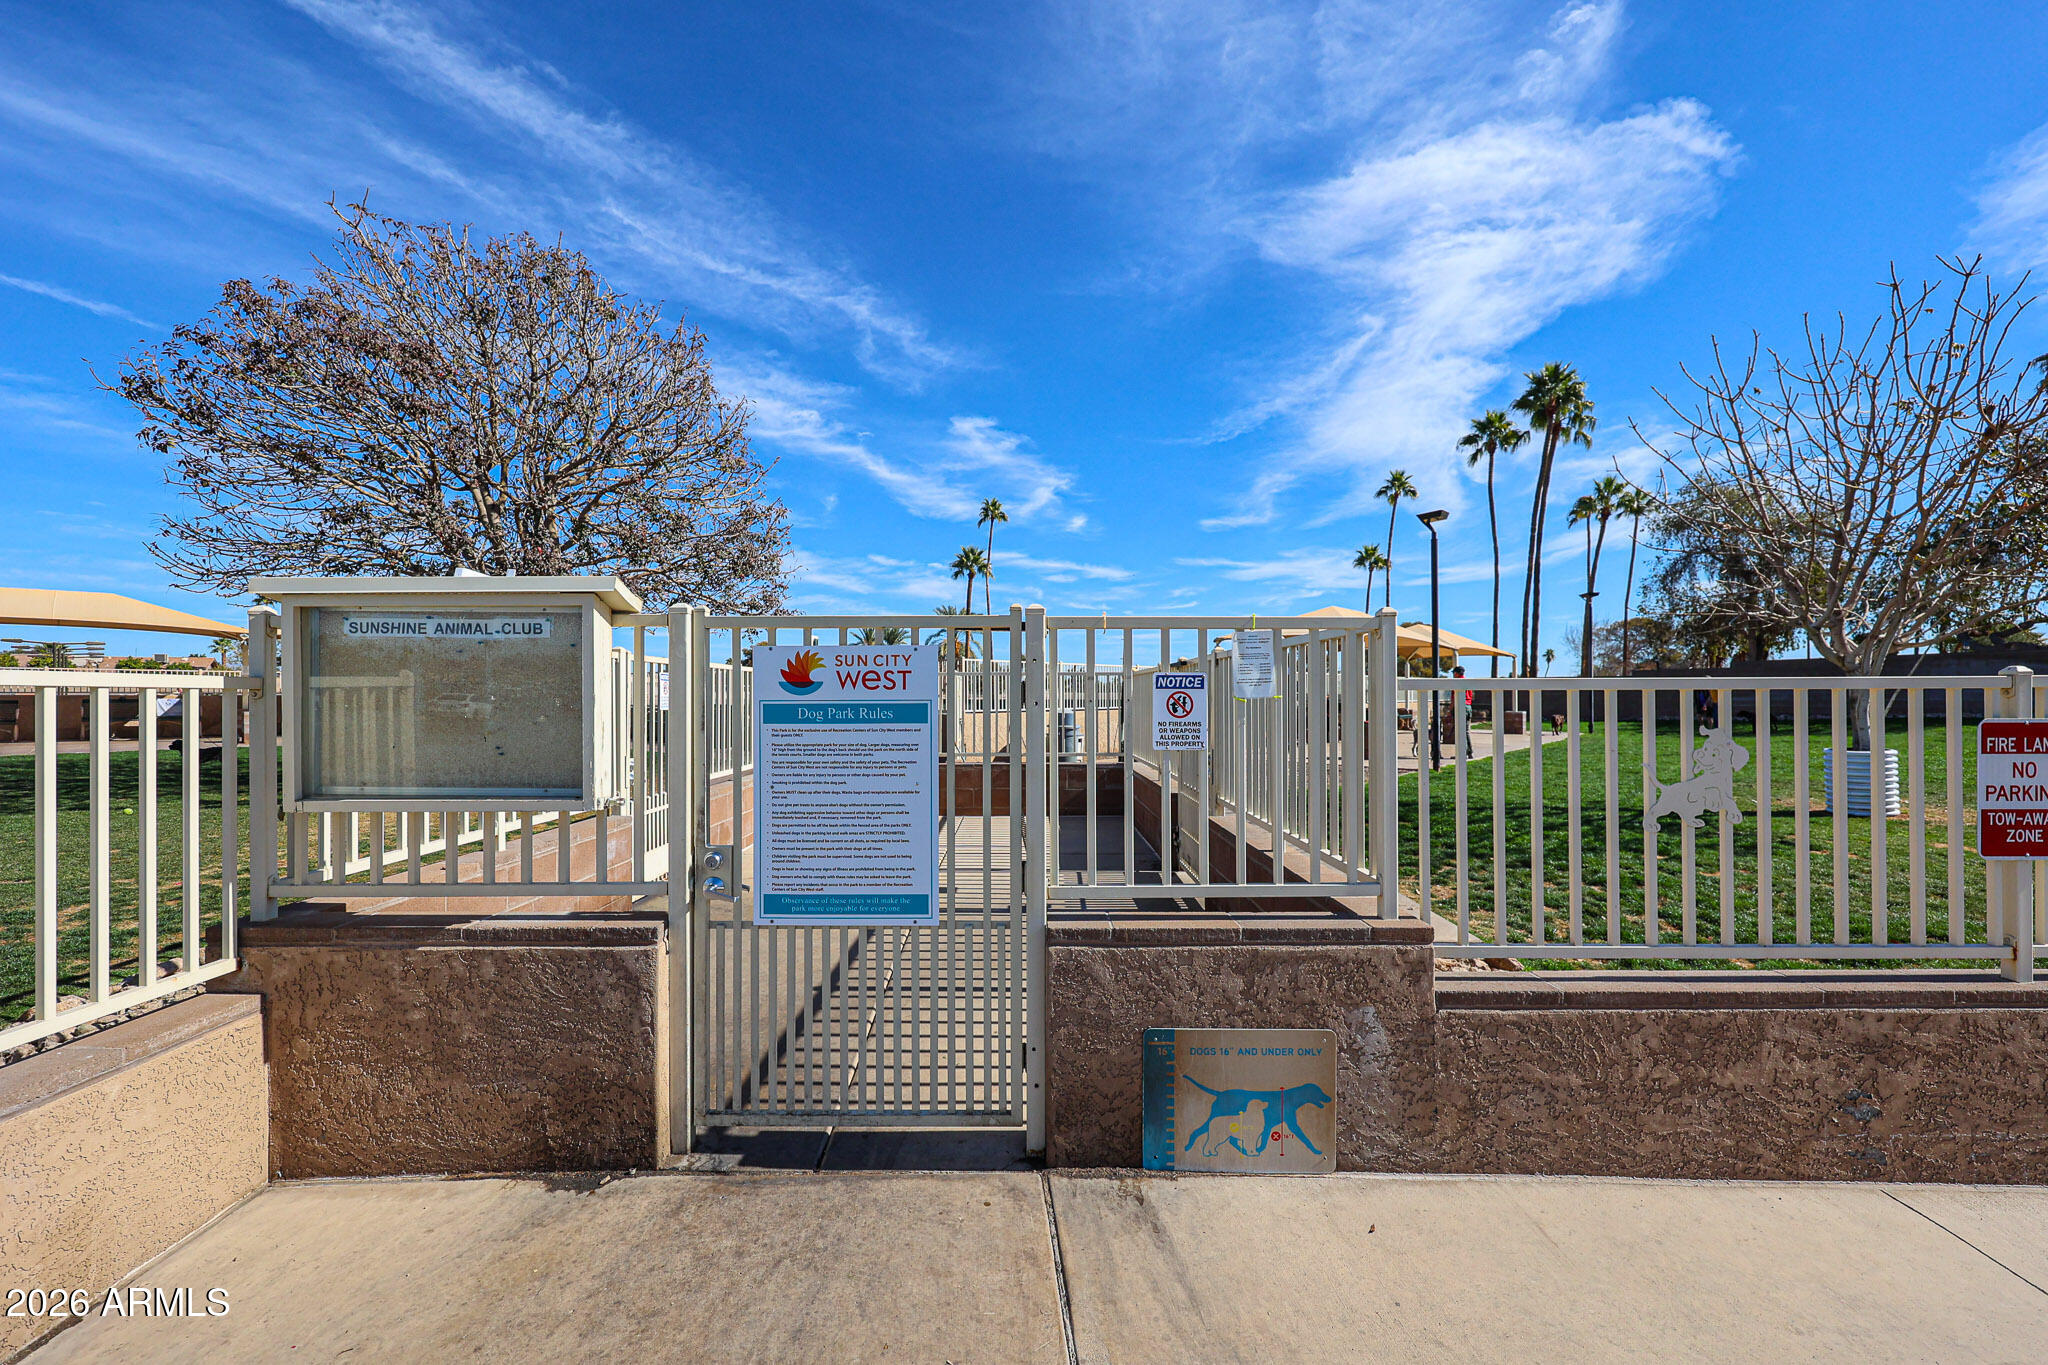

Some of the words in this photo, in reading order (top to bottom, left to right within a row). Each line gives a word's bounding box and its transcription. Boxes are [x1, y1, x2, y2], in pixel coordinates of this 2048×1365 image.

[348, 622, 428, 634] SUNSHINE
[434, 622, 494, 635] ANIMAL
[502, 622, 544, 635] CLUB
[835, 654, 868, 667] SUN
[873, 654, 912, 667] CITY
[1157, 677, 1202, 687] NOTICE
[798, 708, 824, 721] Dog
[828, 708, 854, 719] Park
[860, 708, 893, 719] Rules
[1986, 737, 2017, 752] FIRE
[2012, 762, 2037, 778] NO
[1985, 785, 2048, 801] PARKIN
[2006, 829, 2044, 843] ZONE
[1190, 1048, 1216, 1056] DOGS
[1220, 1048, 1234, 1056] 16"
[1238, 1048, 1258, 1056] AND
[1262, 1048, 1294, 1056] UNDER
[1297, 1048, 1322, 1056] ONLY
